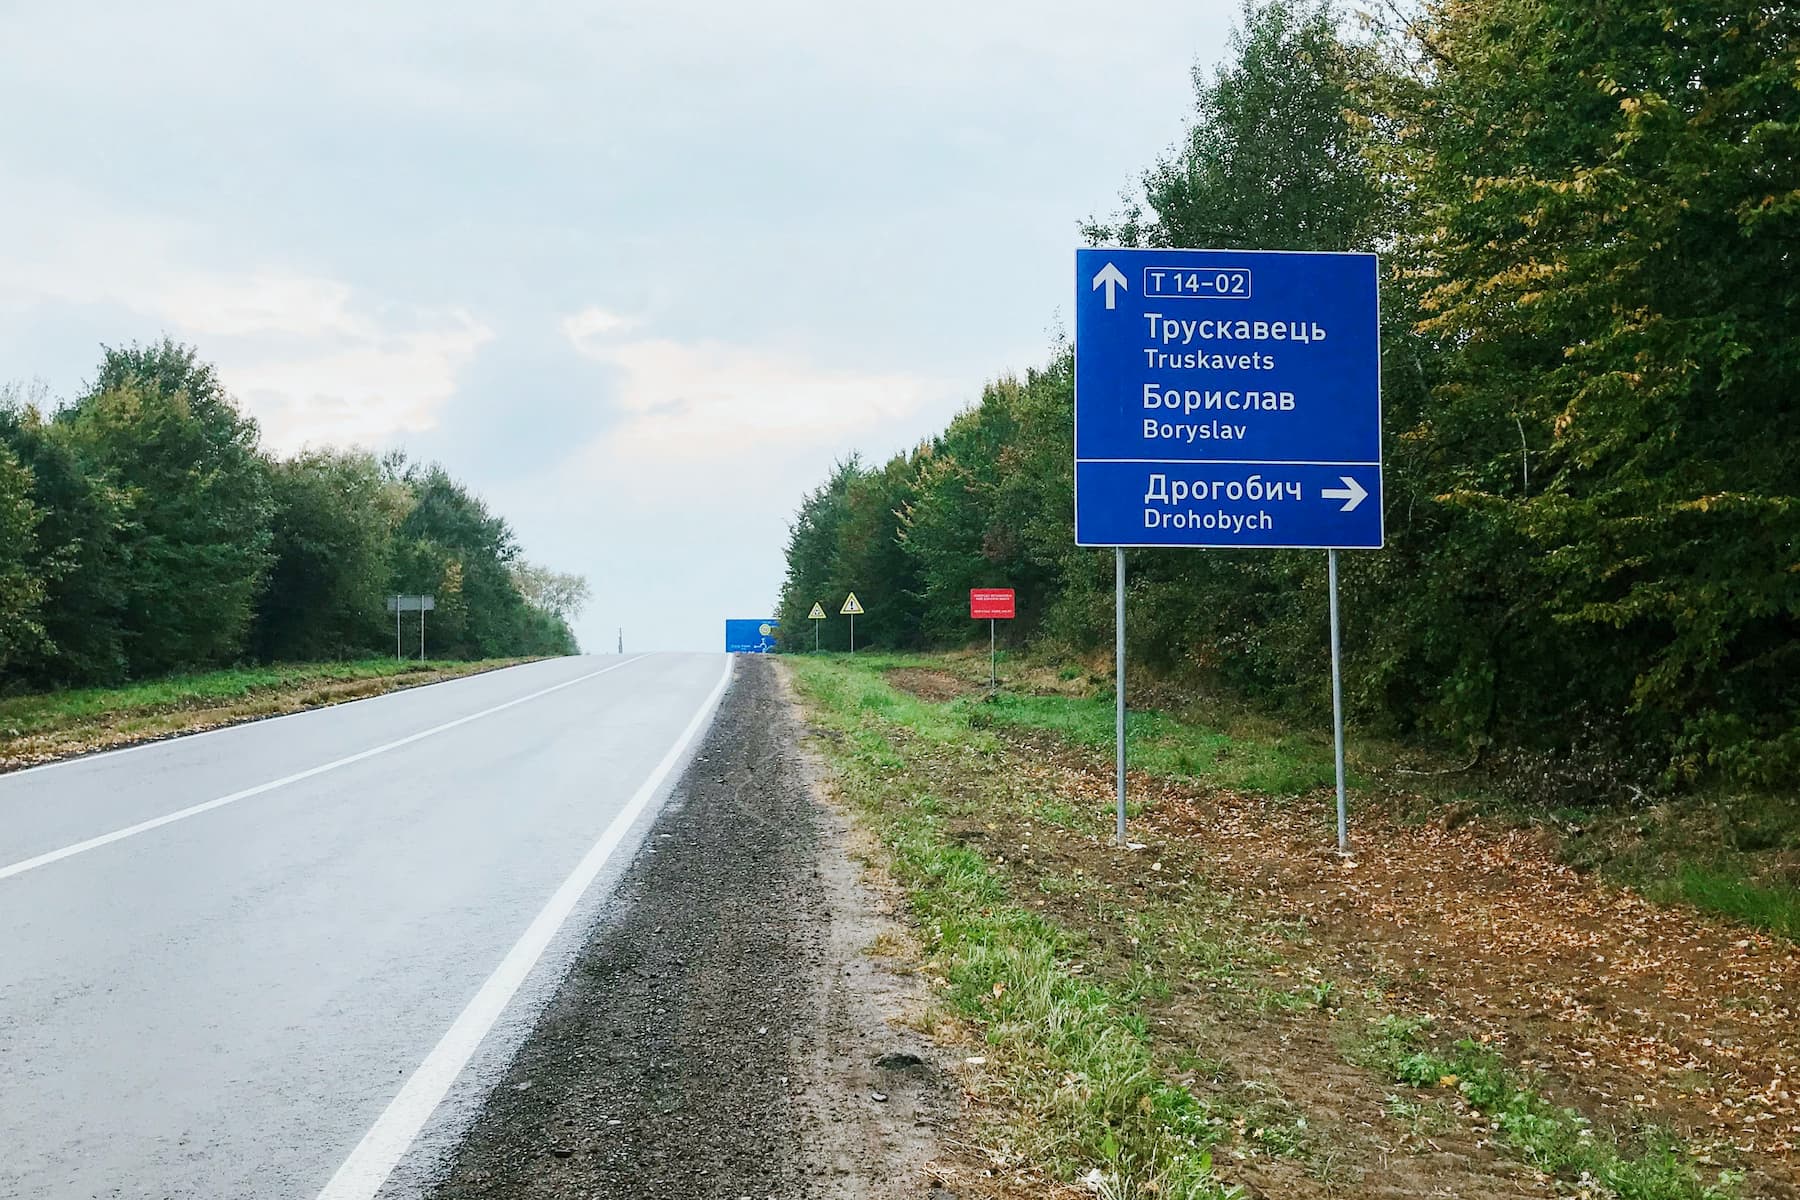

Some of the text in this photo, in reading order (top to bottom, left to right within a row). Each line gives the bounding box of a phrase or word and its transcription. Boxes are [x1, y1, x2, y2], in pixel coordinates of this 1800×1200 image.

[1173, 273, 1245, 294] 14-02
[1143, 313, 1327, 345] Трускавець
[1143, 348, 1275, 370] Truskavets
[1143, 383, 1296, 415] Борислав
[1143, 419, 1247, 444] Boryslav
[1144, 474, 1302, 506] Дрогобич
[1144, 508, 1273, 534] Drohobych
